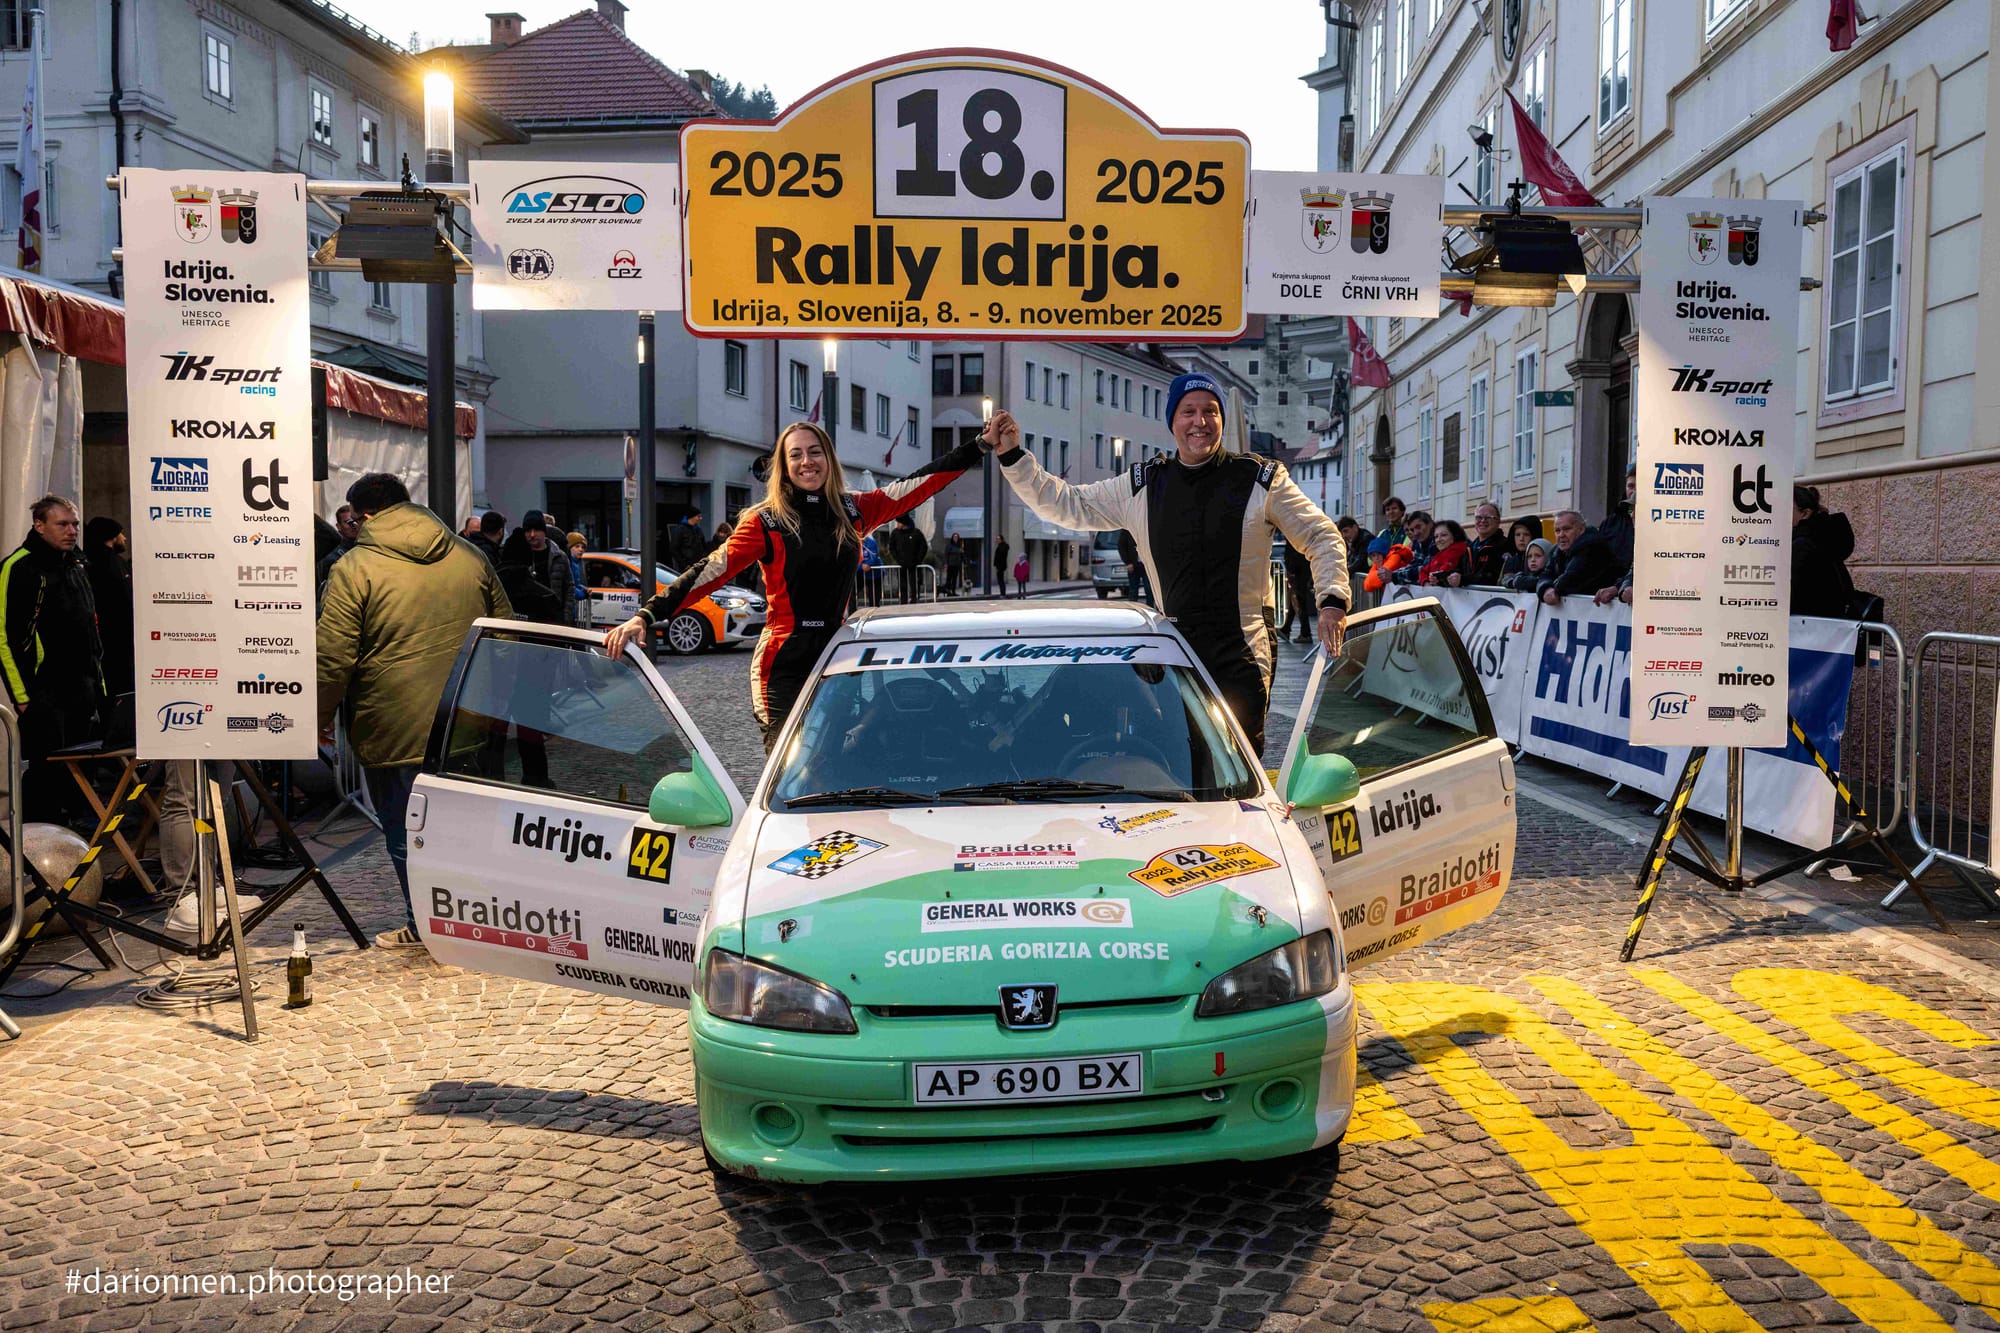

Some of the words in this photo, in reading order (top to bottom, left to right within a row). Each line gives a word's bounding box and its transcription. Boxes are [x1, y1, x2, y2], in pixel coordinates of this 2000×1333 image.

[896, 87, 1055, 201] 18.
[709, 150, 843, 198] 2025
[1096, 158, 1225, 205] 2025
[570, 216, 596, 224] ŠPORT
[164, 260, 234, 282] Idrija.
[755, 225, 942, 301] Rally
[961, 224, 1180, 302] Idrija.
[1272, 272, 1300, 281] Krajevna
[1301, 273, 1331, 282] skupnost
[1380, 275, 1410, 283] skupnost
[164, 284, 275, 304] Slovenia.
[1280, 284, 1323, 299] DOLE
[1342, 282, 1380, 300] ČRNI
[1385, 287, 1418, 301] VRH
[1677, 280, 1736, 302] Idrija.
[712, 298, 790, 327] Idrija,
[797, 299, 929, 328] Slovenija,
[937, 302, 960, 324] 8.
[989, 303, 1011, 325] 9.
[1020, 304, 1153, 326] november
[1161, 304, 1223, 327] 2025
[1676, 302, 1770, 321] Slovenia.
[182, 319, 230, 327] HERITAGE
[1689, 327, 1724, 335] UNESCO
[1688, 335, 1731, 343] HERITAGE
[210, 366, 282, 385] sport
[240, 384, 276, 396] racing
[1710, 379, 1774, 397] sport
[1735, 396, 1766, 408] racing
[171, 419, 276, 440] KROKAR
[1674, 428, 1765, 448] KROKAR
[150, 457, 208, 485] ZIDGRAD
[1654, 463, 1704, 489] ZIDGRAD
[166, 507, 212, 517] PETRE
[243, 513, 290, 522] brusteam
[1666, 509, 1705, 520] PETRE
[1732, 515, 1772, 524] brusteam
[233, 535, 248, 543] GB
[264, 536, 301, 546] Leasing
[1722, 536, 1735, 544] GB
[1748, 536, 1780, 547] Leasing
[153, 591, 207, 600] eMravljica
[608, 594, 634, 603] Idrija.
[1650, 588, 1696, 597] eMravljica
[1720, 596, 1778, 607] Laprina
[234, 599, 302, 611] Laprina
[245, 637, 293, 646] PREVOZI
[1727, 632, 1769, 640] PREVOZI
[979, 643, 1159, 663] Motorsport
[151, 668, 218, 678] JEREB
[1644, 660, 1703, 670] JEREB
[237, 673, 303, 695] mireo
[1718, 665, 1776, 686] mireo
[1650, 697, 1689, 720] Just
[160, 707, 205, 733] Just
[1370, 789, 1442, 837] Idrija.
[512, 813, 612, 863] Idrija.
[1331, 811, 1361, 856] 42
[630, 833, 670, 879] 42
[961, 843, 1072, 853] Braidotti
[1219, 846, 1249, 857] 2025
[1174, 849, 1216, 867] 42
[1141, 867, 1174, 880] 2025
[1163, 869, 1208, 887] Rally
[1205, 858, 1257, 874] Idrija.
[1400, 843, 1500, 906] Braidotti
[927, 903, 1008, 921] GENERAL
[1013, 901, 1077, 917] WORKS
[1406, 886, 1468, 919] MOTO
[432, 886, 582, 941] Braidotti
[445, 923, 536, 949] MOTO
[605, 927, 659, 956] GENERAL
[1387, 925, 1421, 947] CORSE
[884, 944, 993, 968] SCUDERIA
[1001, 942, 1092, 961] GORIZIA
[1098, 942, 1170, 961] CORSE
[555, 963, 626, 988] SCUDERIA
[630, 977, 691, 1000] GORIZIA
[927, 1070, 980, 1097] AP
[995, 1065, 1061, 1094] 690
[1079, 1061, 1131, 1091] BX
